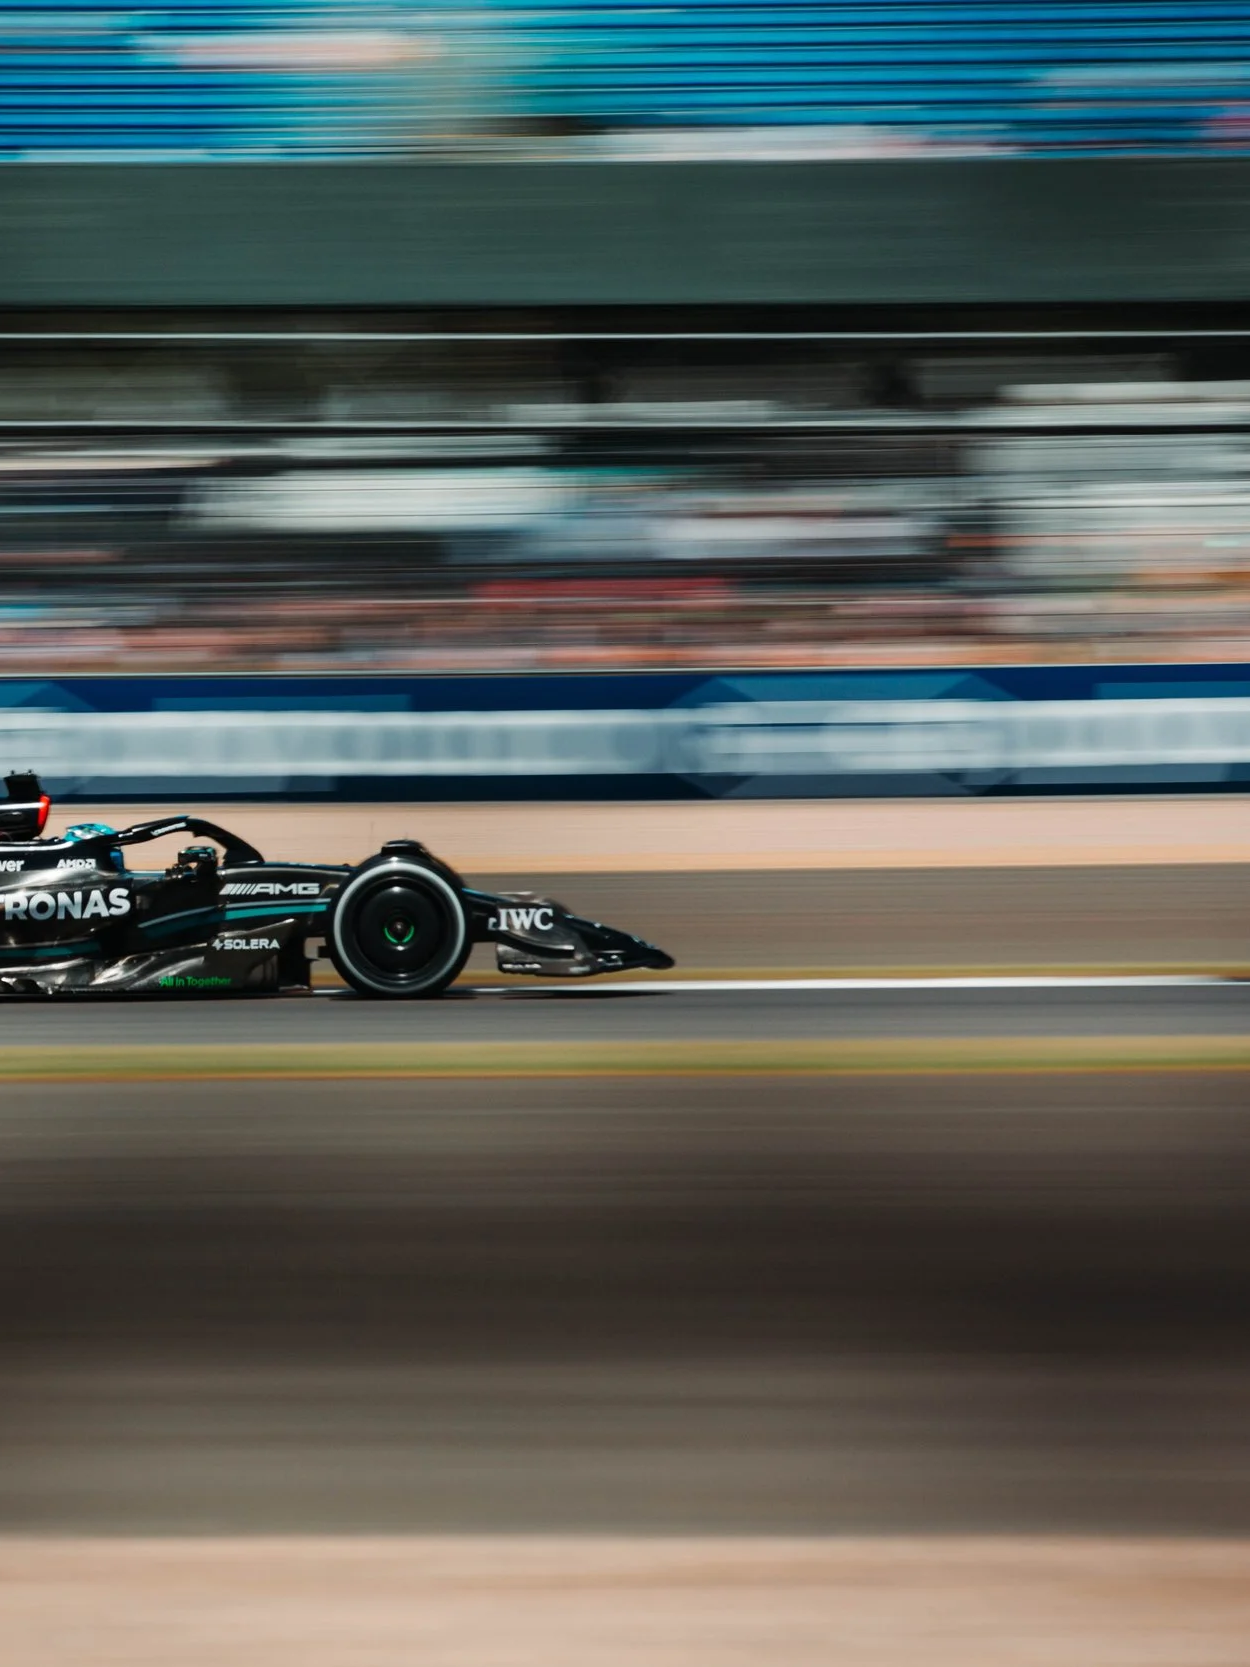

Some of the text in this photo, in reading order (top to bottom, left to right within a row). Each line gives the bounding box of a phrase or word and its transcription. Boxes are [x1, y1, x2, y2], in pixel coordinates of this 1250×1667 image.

[56, 858, 86, 869] AMD
[253, 883, 320, 895] AMG
[498, 908, 553, 931] IWC
[224, 938, 280, 950] SOLERA
[187, 976, 232, 987] Together
